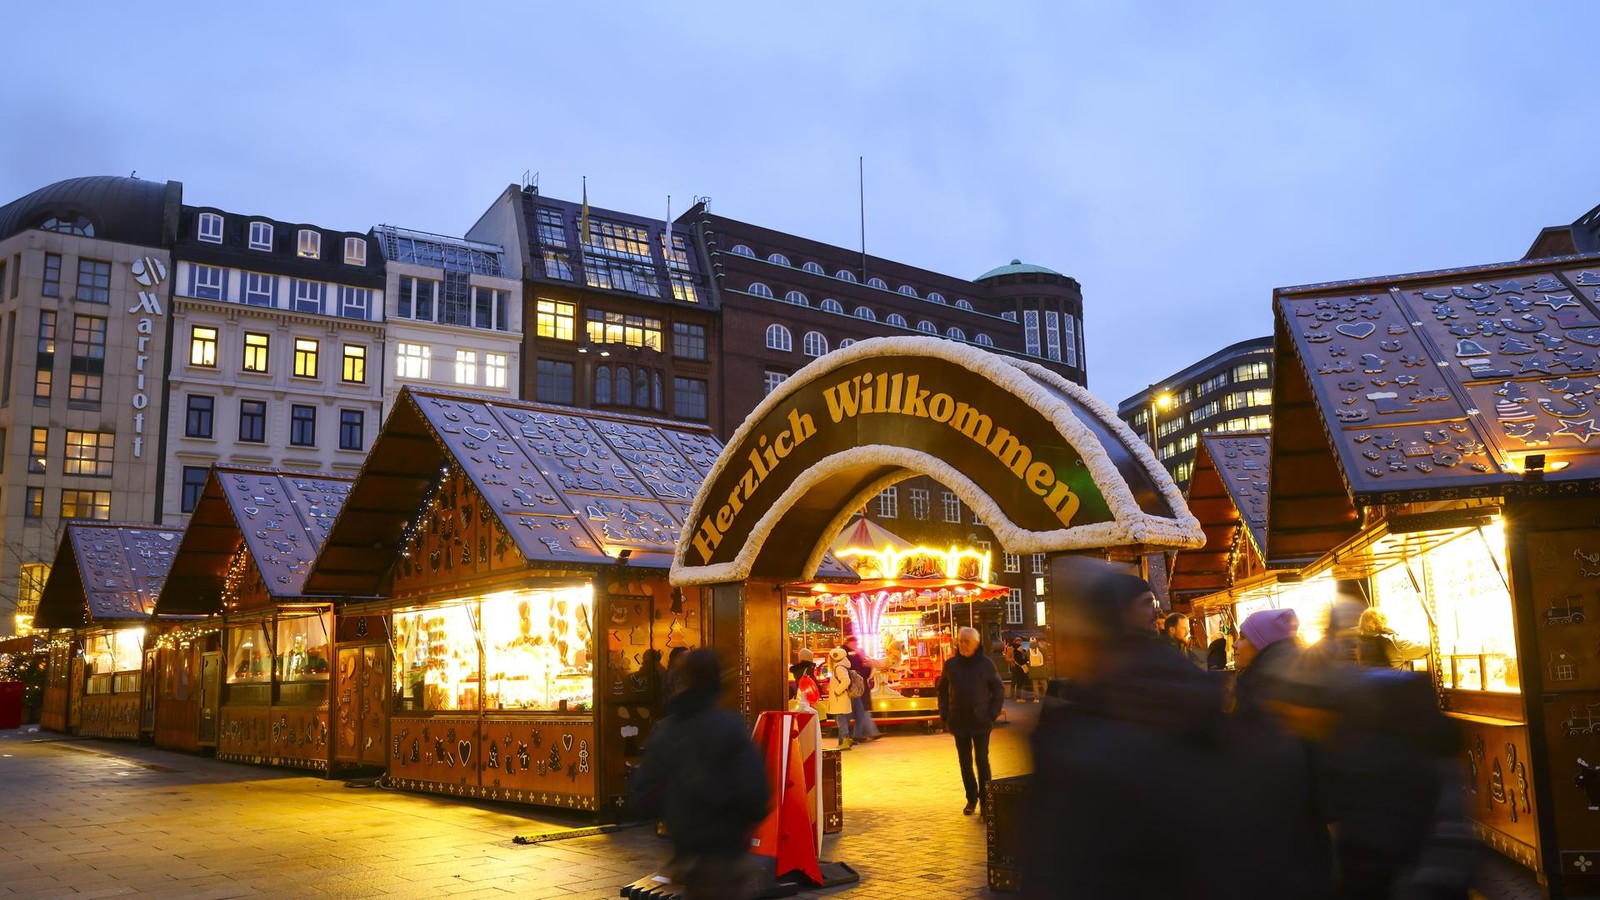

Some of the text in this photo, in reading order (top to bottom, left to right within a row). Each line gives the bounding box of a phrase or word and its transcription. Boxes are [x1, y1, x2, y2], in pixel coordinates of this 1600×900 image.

[128, 291, 162, 458] Marriott
[693, 372, 1081, 564] Herzlich Willkommen
